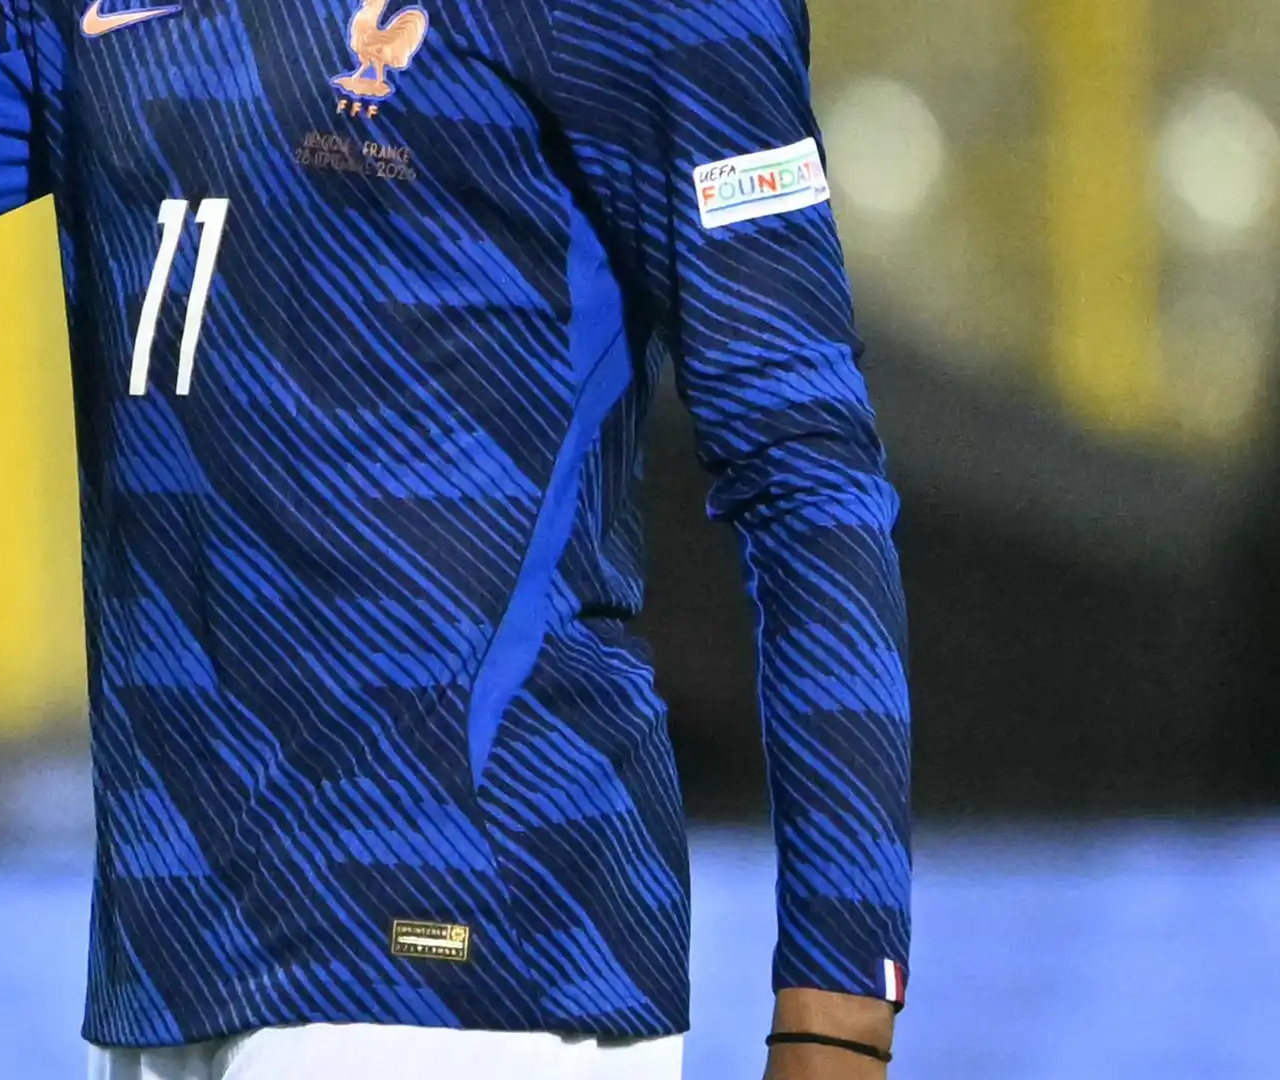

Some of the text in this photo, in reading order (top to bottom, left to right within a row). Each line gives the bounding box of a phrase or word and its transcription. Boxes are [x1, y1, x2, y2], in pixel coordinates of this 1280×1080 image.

[362, 140, 410, 162] FRANCE
[699, 164, 736, 183] UEFA
[701, 162, 817, 207] FOUNDAT
[129, 198, 230, 395] 11
